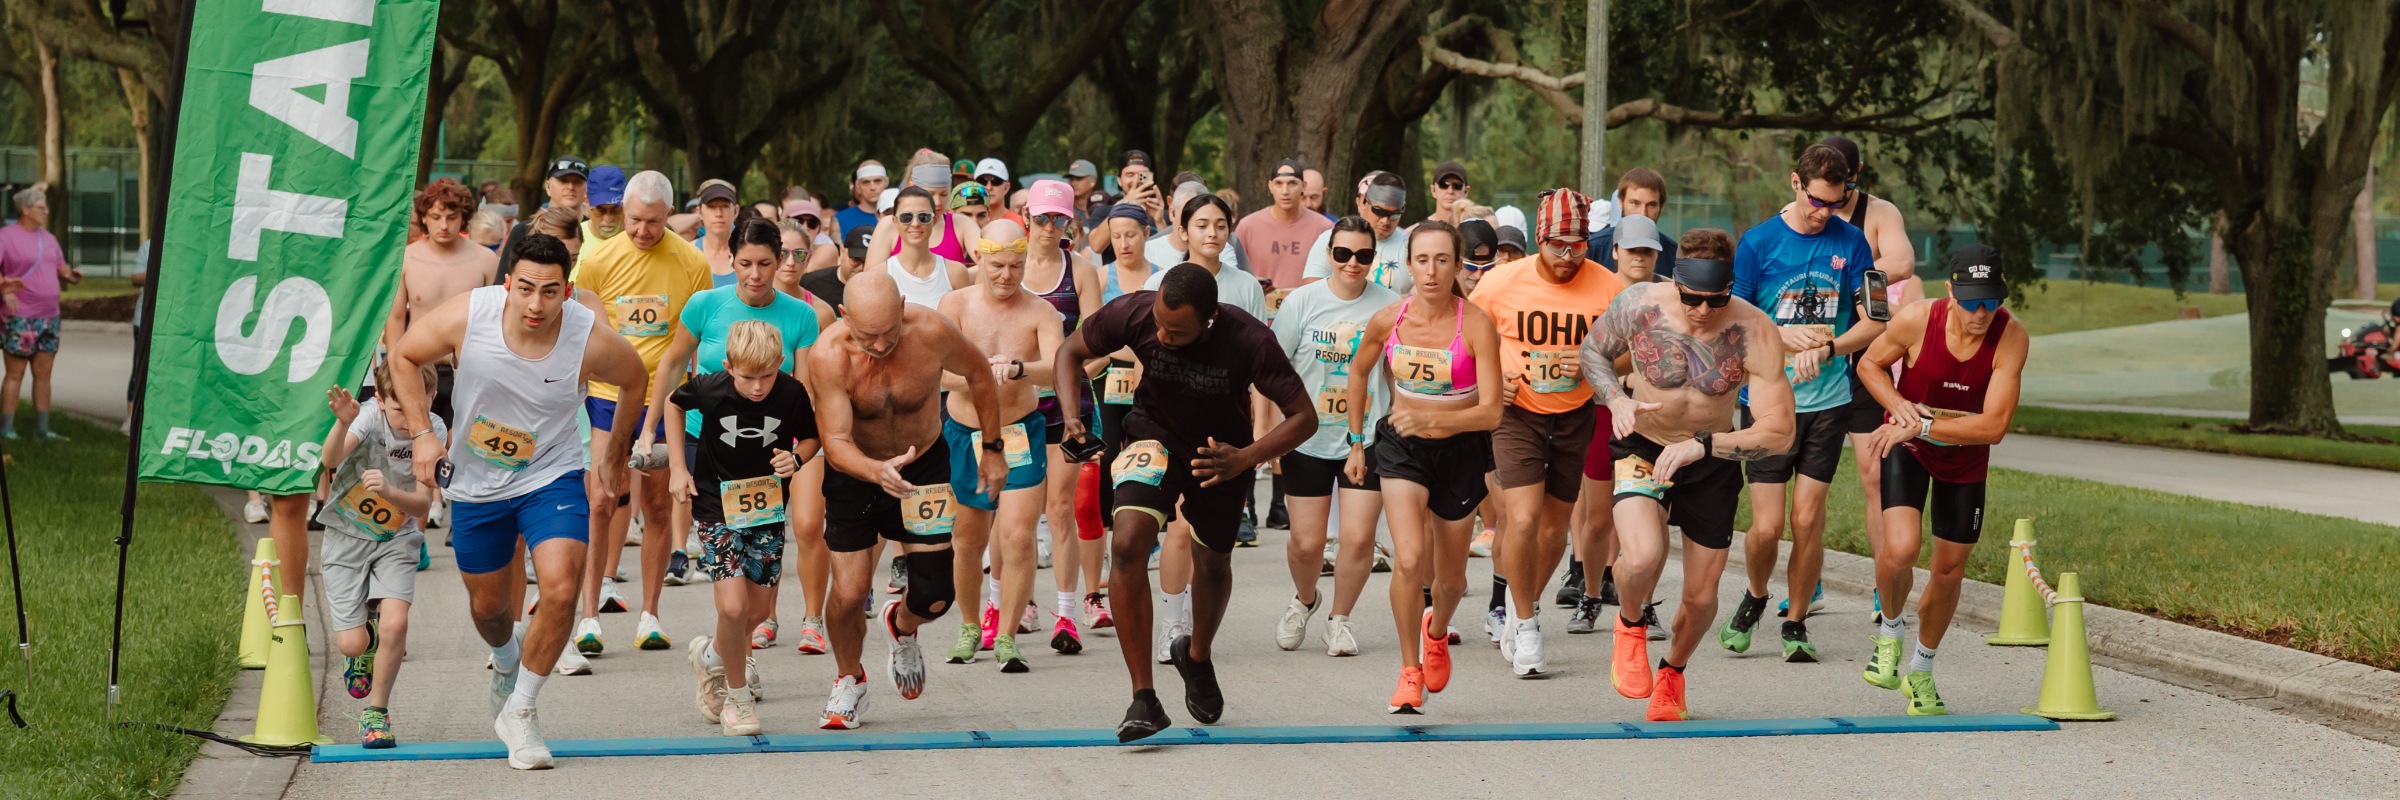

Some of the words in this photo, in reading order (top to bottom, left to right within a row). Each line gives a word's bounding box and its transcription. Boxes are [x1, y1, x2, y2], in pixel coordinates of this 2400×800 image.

[628, 308, 657, 324] 40
[1312, 330, 1336, 344] RUN
[1315, 349, 1354, 364] RESORT
[1398, 348, 1412, 356] RUN
[1416, 350, 1440, 359] RESORT
[1408, 362, 1434, 382] 75
[1539, 364, 1562, 380] 10
[1116, 380, 1134, 393] 11
[1326, 398, 1348, 414] 10
[481, 420, 496, 430] RUN
[500, 426, 527, 438] RESORT
[484, 436, 518, 456] 49
[1124, 452, 1152, 470] 79
[1632, 464, 1650, 479] 5
[728, 482, 740, 490] RUN
[746, 479, 770, 488] RESORT
[925, 486, 950, 494] RESORT
[739, 492, 768, 512] 58
[918, 499, 947, 520] 67
[358, 498, 392, 525] 60
